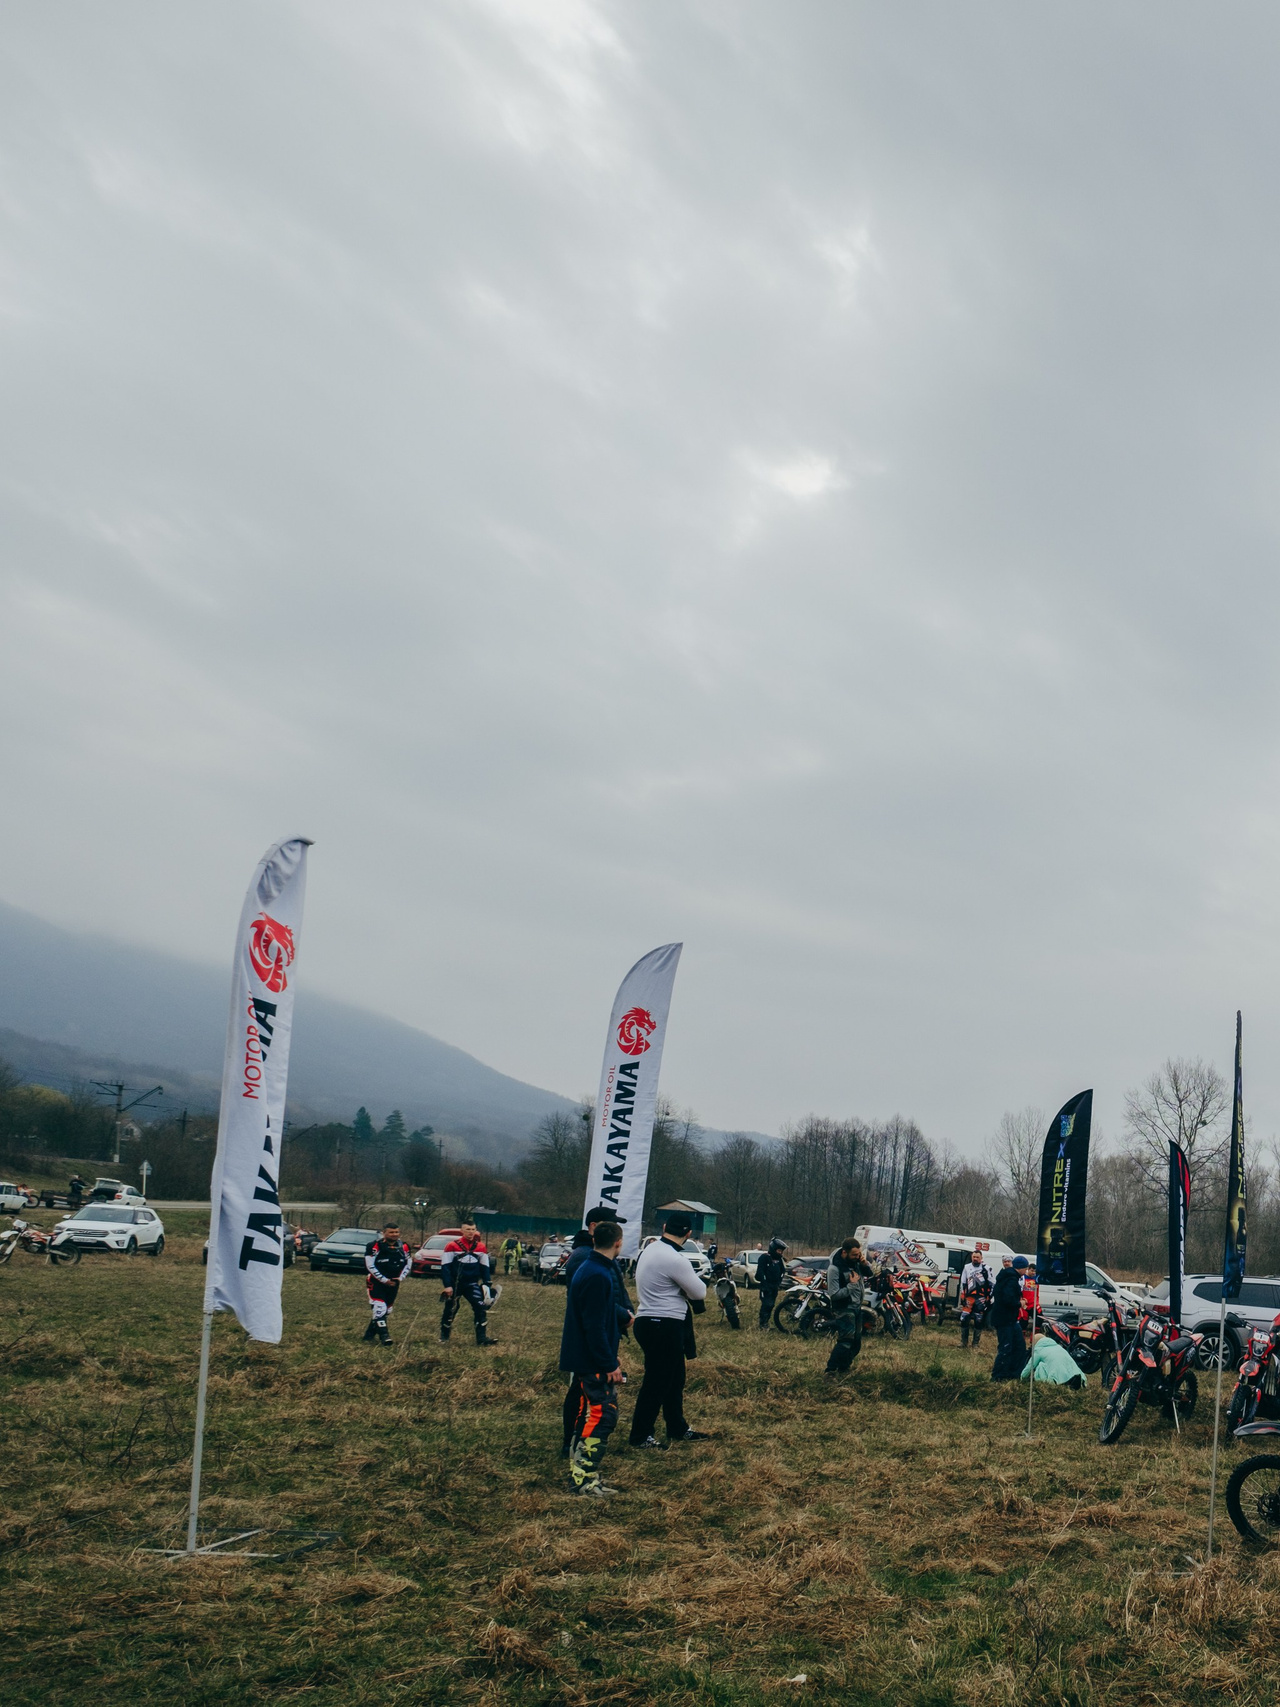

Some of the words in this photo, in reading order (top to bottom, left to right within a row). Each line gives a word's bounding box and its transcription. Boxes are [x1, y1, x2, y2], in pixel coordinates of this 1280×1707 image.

[243, 1025, 262, 1100] MOTOR
[607, 1065, 617, 1084] OIL
[602, 1086, 613, 1127] MOTOR
[600, 1061, 640, 1213] AKAYAMA
[1051, 1143, 1067, 1223] NITREX
[975, 1241, 990, 1251] 33
